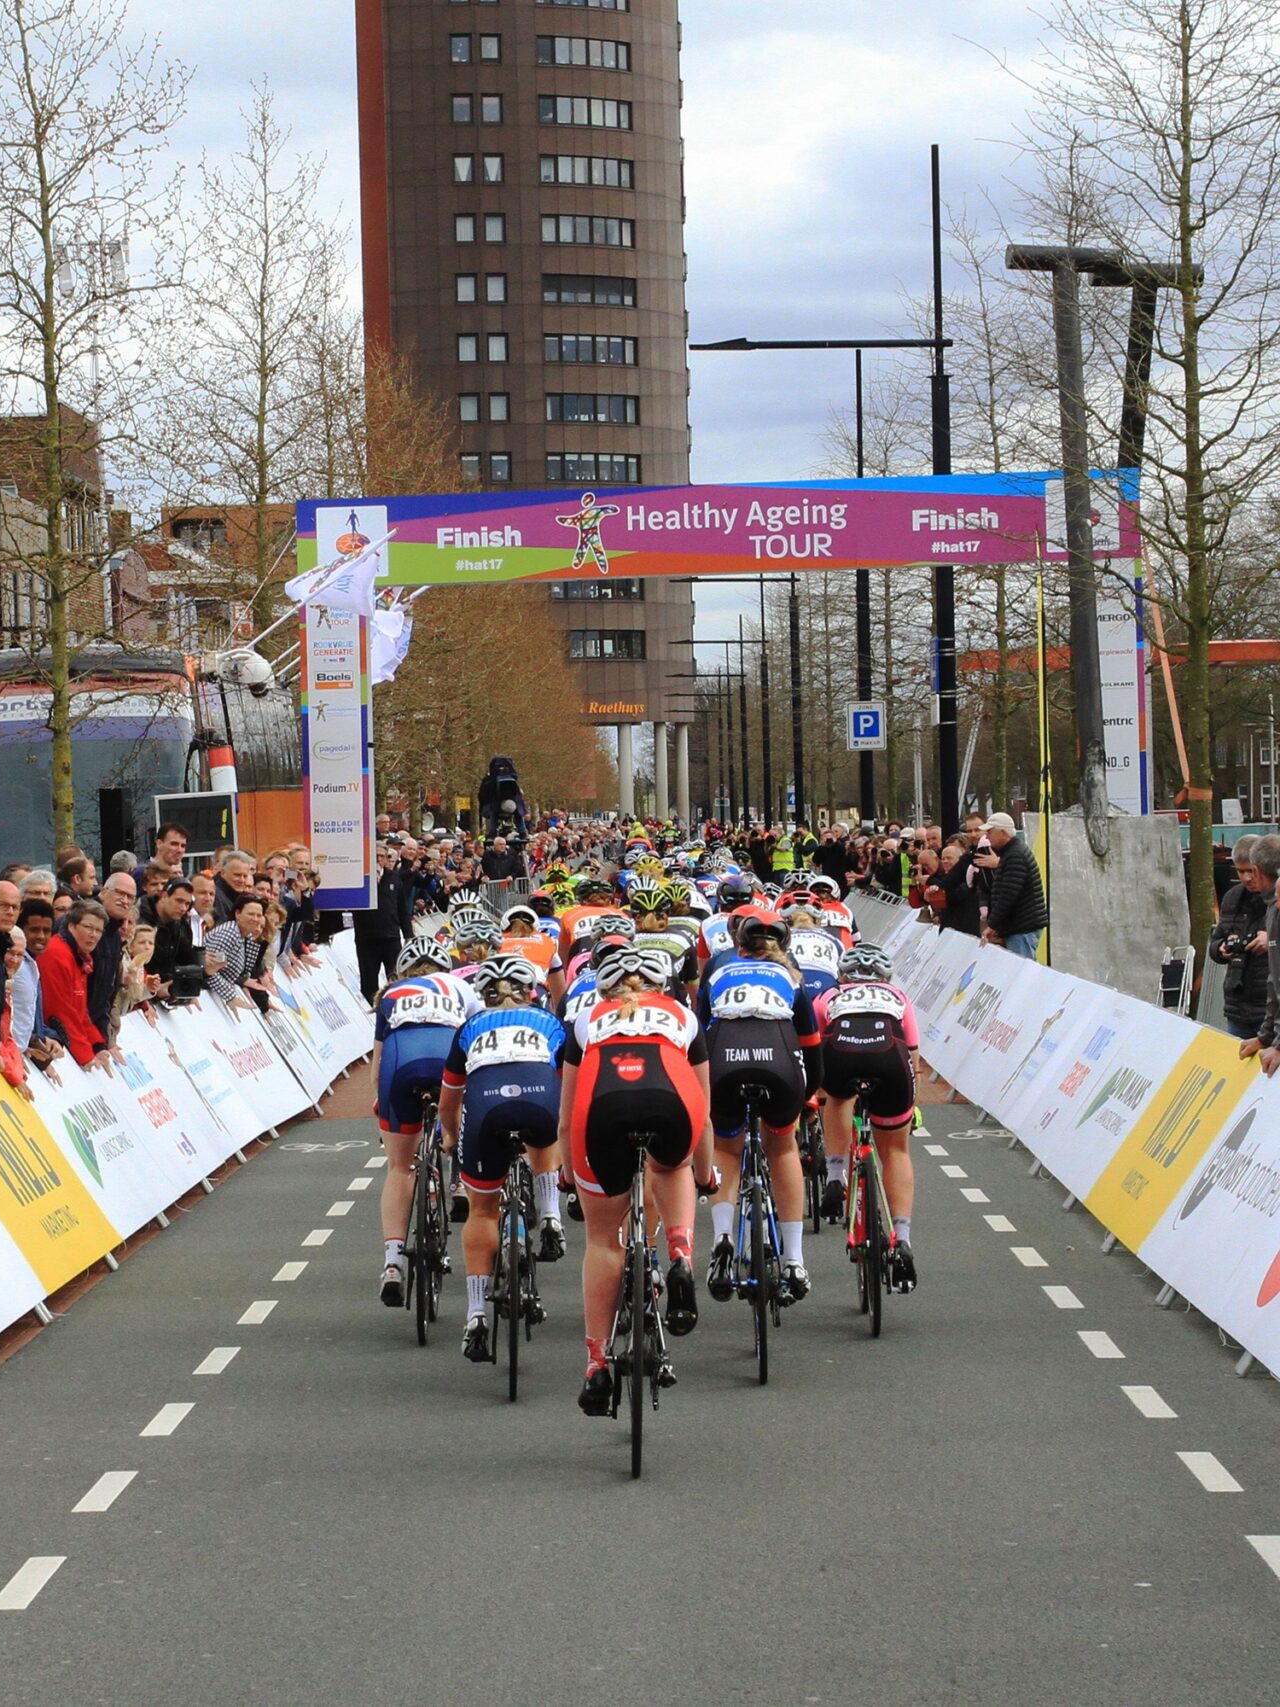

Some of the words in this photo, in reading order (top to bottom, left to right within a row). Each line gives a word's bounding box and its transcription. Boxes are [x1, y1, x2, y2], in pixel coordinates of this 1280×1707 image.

[626, 502, 738, 535] Healthy
[745, 498, 848, 532] Ageing
[912, 507, 999, 531] Finish
[436, 525, 522, 549] Finish
[749, 533, 832, 559] TOUR
[931, 540, 980, 553] #hat17
[455, 558, 503, 571] #hat17
[316, 673, 351, 681] Boels
[588, 701, 645, 717] Raethuys
[859, 714, 874, 735] P
[1103, 716, 1133, 726] entric
[313, 783, 360, 793] Podium.TV
[730, 969, 753, 977] TEAM
[756, 969, 777, 978] WNT
[473, 1030, 498, 1054] 44
[513, 1030, 540, 1050] 44
[725, 1048, 750, 1062] TEAM
[752, 1047, 773, 1061] WNT
[522, 1085, 546, 1094] SEIER
